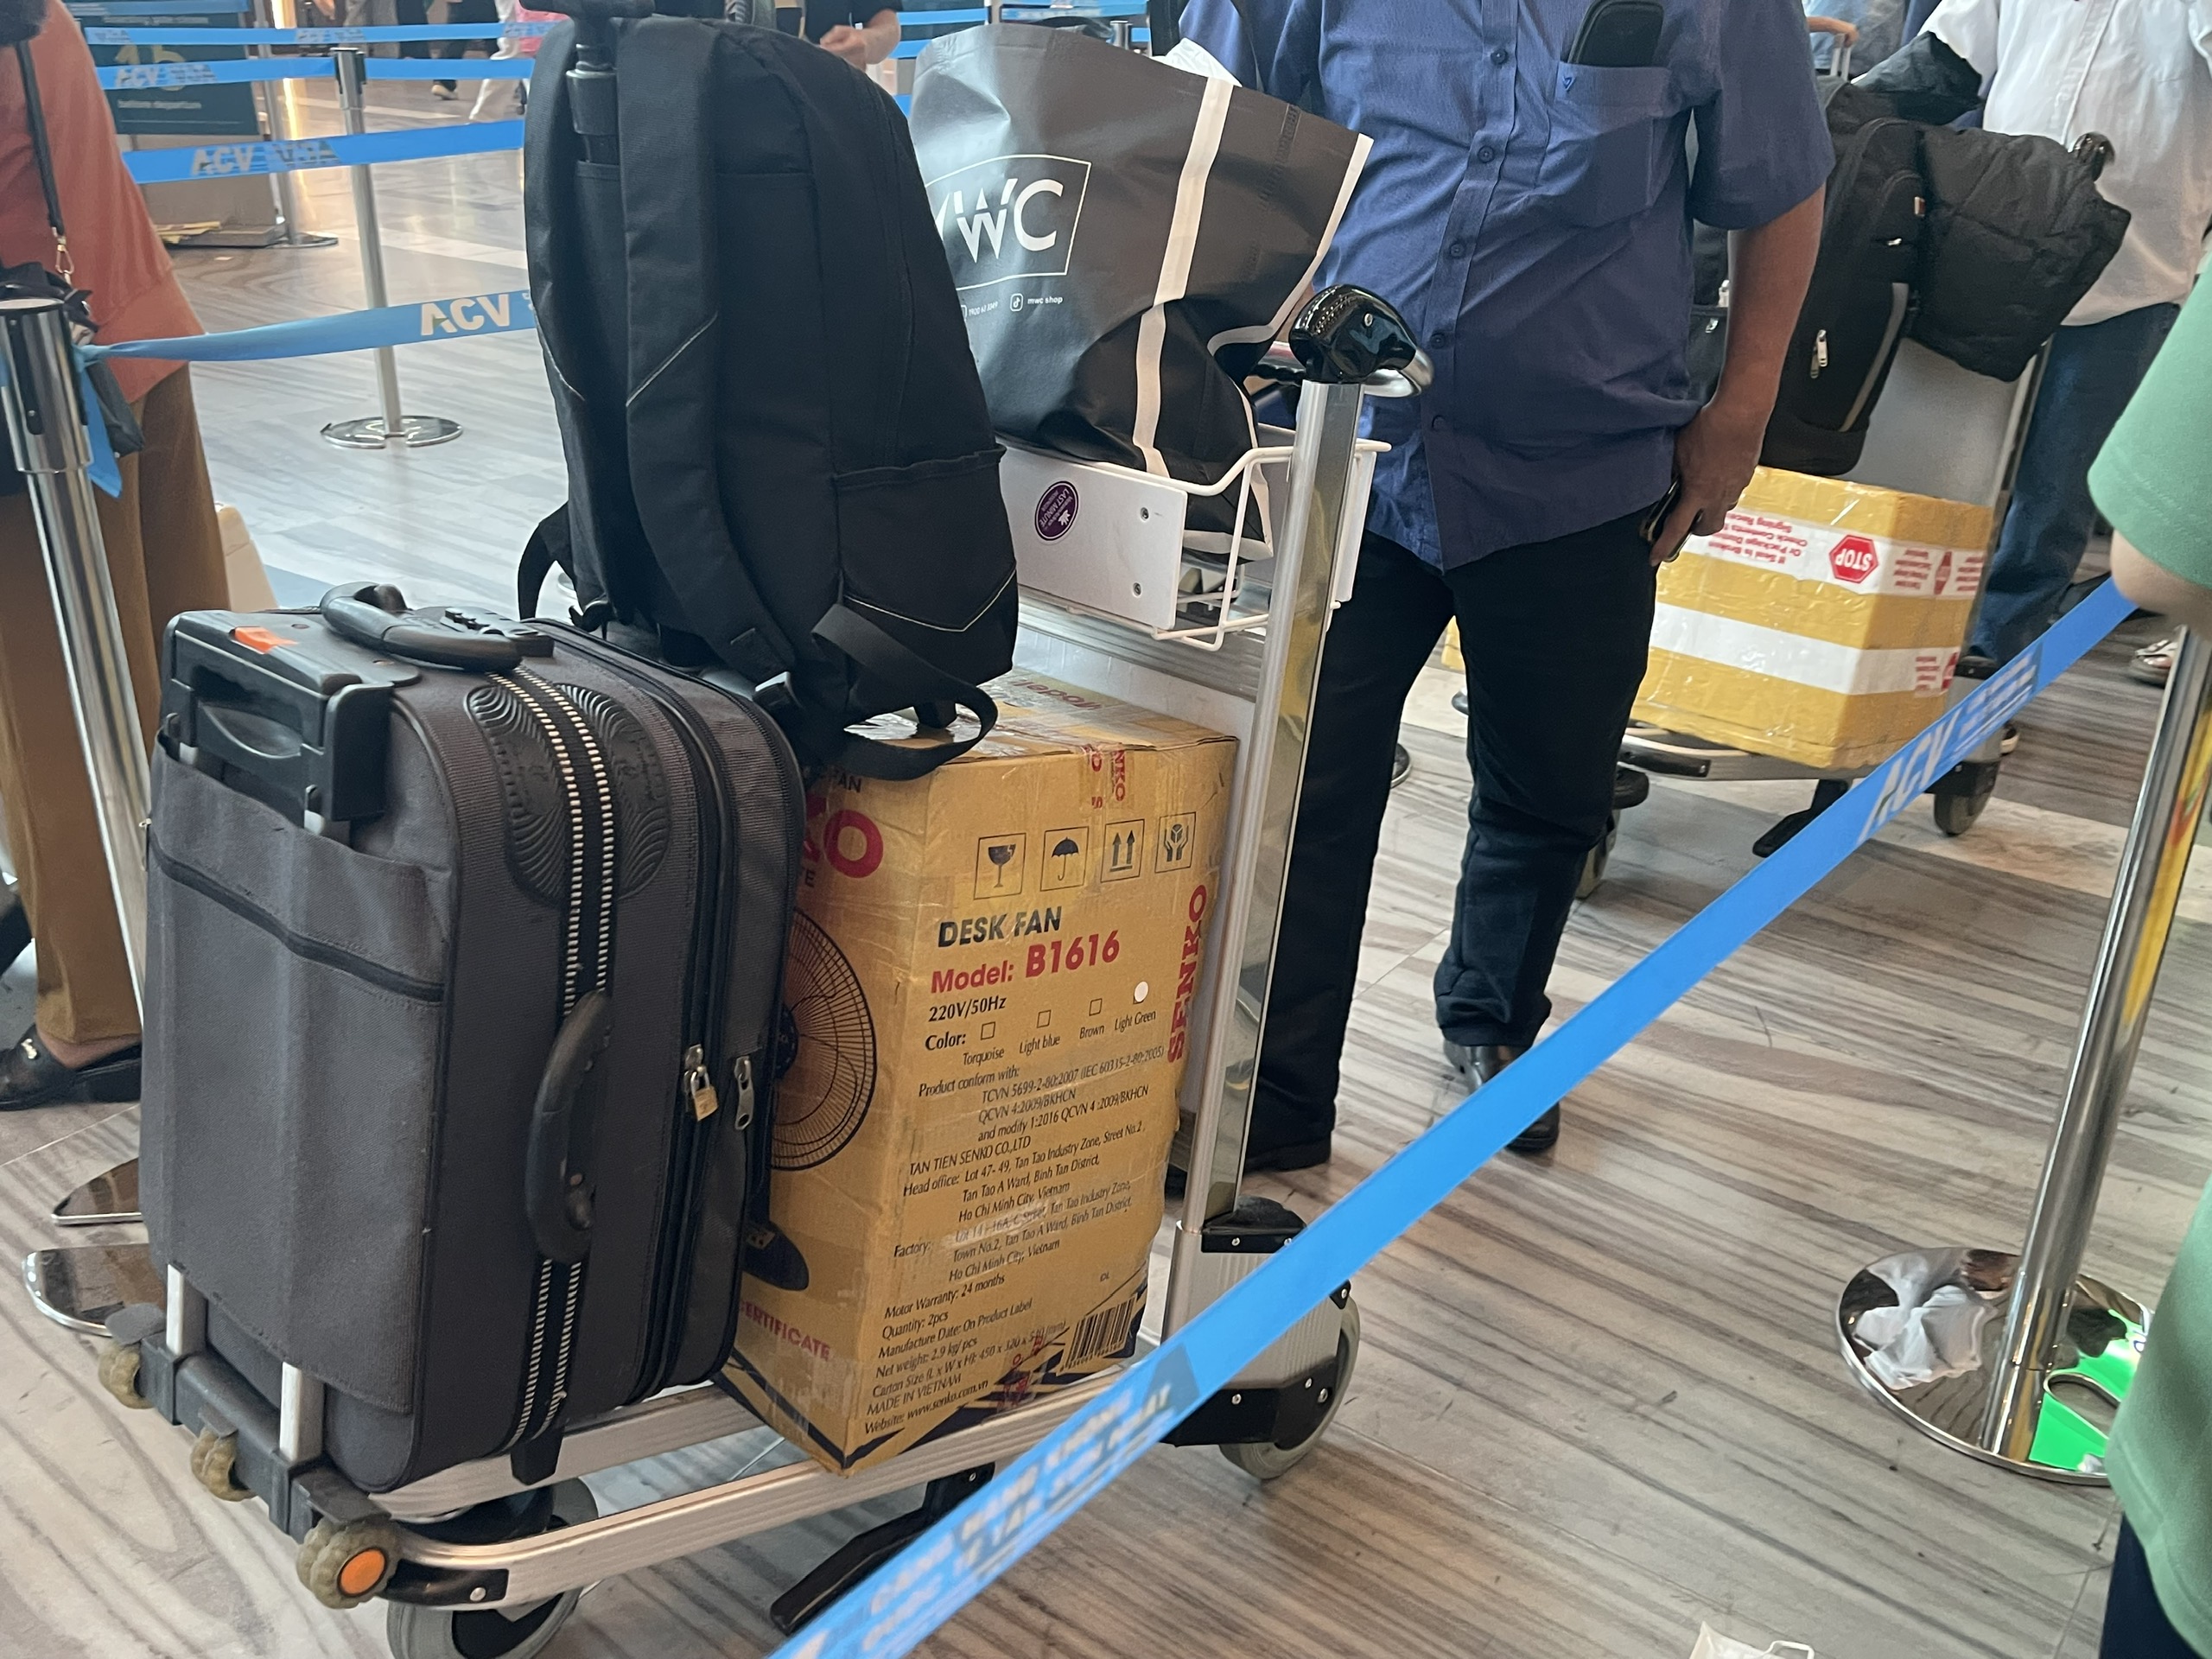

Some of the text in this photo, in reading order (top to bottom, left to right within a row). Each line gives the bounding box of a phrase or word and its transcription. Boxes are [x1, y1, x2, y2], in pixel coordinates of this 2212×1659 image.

[191, 146, 255, 176] ACV
[421, 294, 511, 335] ACV
[1045, 296, 1064, 304] shop
[1056, 488, 1070, 506] LAST
[1835, 548, 1872, 570] STOP
[938, 906, 1062, 948] DESK FAN
[931, 930, 1120, 994] Model: B1616
[1167, 885, 1207, 1063] SENKO
[928, 995, 1007, 1022] 220V/50Hz
[925, 1031, 966, 1051] Color:
[1019, 1039, 1040, 1056] Light
[1042, 1033, 1061, 1049] blue
[1079, 1025, 1105, 1039] Brown
[1115, 1015, 1133, 1033] Light
[1135, 1010, 1157, 1026] Green
[918, 1065, 1020, 1097] Product conform with:
[982, 1086, 1010, 1103] TCVN
[977, 1125, 996, 1141] and
[997, 1117, 1028, 1135] modify
[1031, 1110, 1059, 1128] 1:2016
[1060, 1103, 1089, 1122] QCVN
[978, 1104, 1010, 1125] QCVN
[903, 1178, 931, 1197] Head
[931, 1173, 960, 1191] office:
[964, 1170, 978, 1182] Lot
[1014, 1156, 1029, 1169] Tan
[1032, 1151, 1046, 1166] Tao
[1047, 1141, 1079, 1160] Industry
[1080, 1136, 1102, 1151] Zone,
[1103, 1128, 1124, 1143] Street
[909, 1160, 931, 1176] TAN
[934, 1154, 957, 1171] TIEN
[959, 1145, 994, 1165] SENKO
[959, 1211, 973, 1223] Ho
[975, 1203, 990, 1218] Chi
[993, 1196, 1014, 1212] Minh
[1038, 1182, 1071, 1199] Vietnam
[963, 1189, 977, 1203] Tan
[981, 1184, 995, 1198] Tao
[996, 1180, 1004, 1194] A
[1007, 1172, 1031, 1190] Ward,
[1033, 1167, 1053, 1183] Binh
[1056, 1163, 1069, 1176] Tan
[893, 1241, 931, 1258] Factory:
[1051, 1202, 1064, 1215] Tan
[1066, 1198, 1079, 1210] Tao
[953, 1247, 976, 1262] Town
[1005, 1235, 1019, 1247] Tan
[1022, 1228, 1036, 1242] Tao
[1037, 1224, 1044, 1236] A
[1071, 1212, 1090, 1226] Binh
[1091, 1206, 1104, 1219] Tan
[950, 1269, 963, 1282] Ho
[965, 1263, 980, 1278] Chi
[982, 1255, 1005, 1271] Minh
[1028, 1239, 1060, 1257] Vietnam
[884, 1273, 1005, 1319] Motor Warranty: 24 months
[878, 1297, 1033, 1359] Manufacture Date: On Product Label
[881, 1311, 949, 1340] Quantity: 2pcs
[873, 1381, 904, 1398] Carton
[905, 1374, 925, 1389] Size
[944, 1359, 957, 1373] W
[875, 1365, 893, 1379] Net
[896, 1353, 930, 1372] weight:
[931, 1346, 946, 1360] 2.9
[867, 1373, 962, 1416] MADE IN VIETNAM
[865, 1414, 906, 1434] Website:
